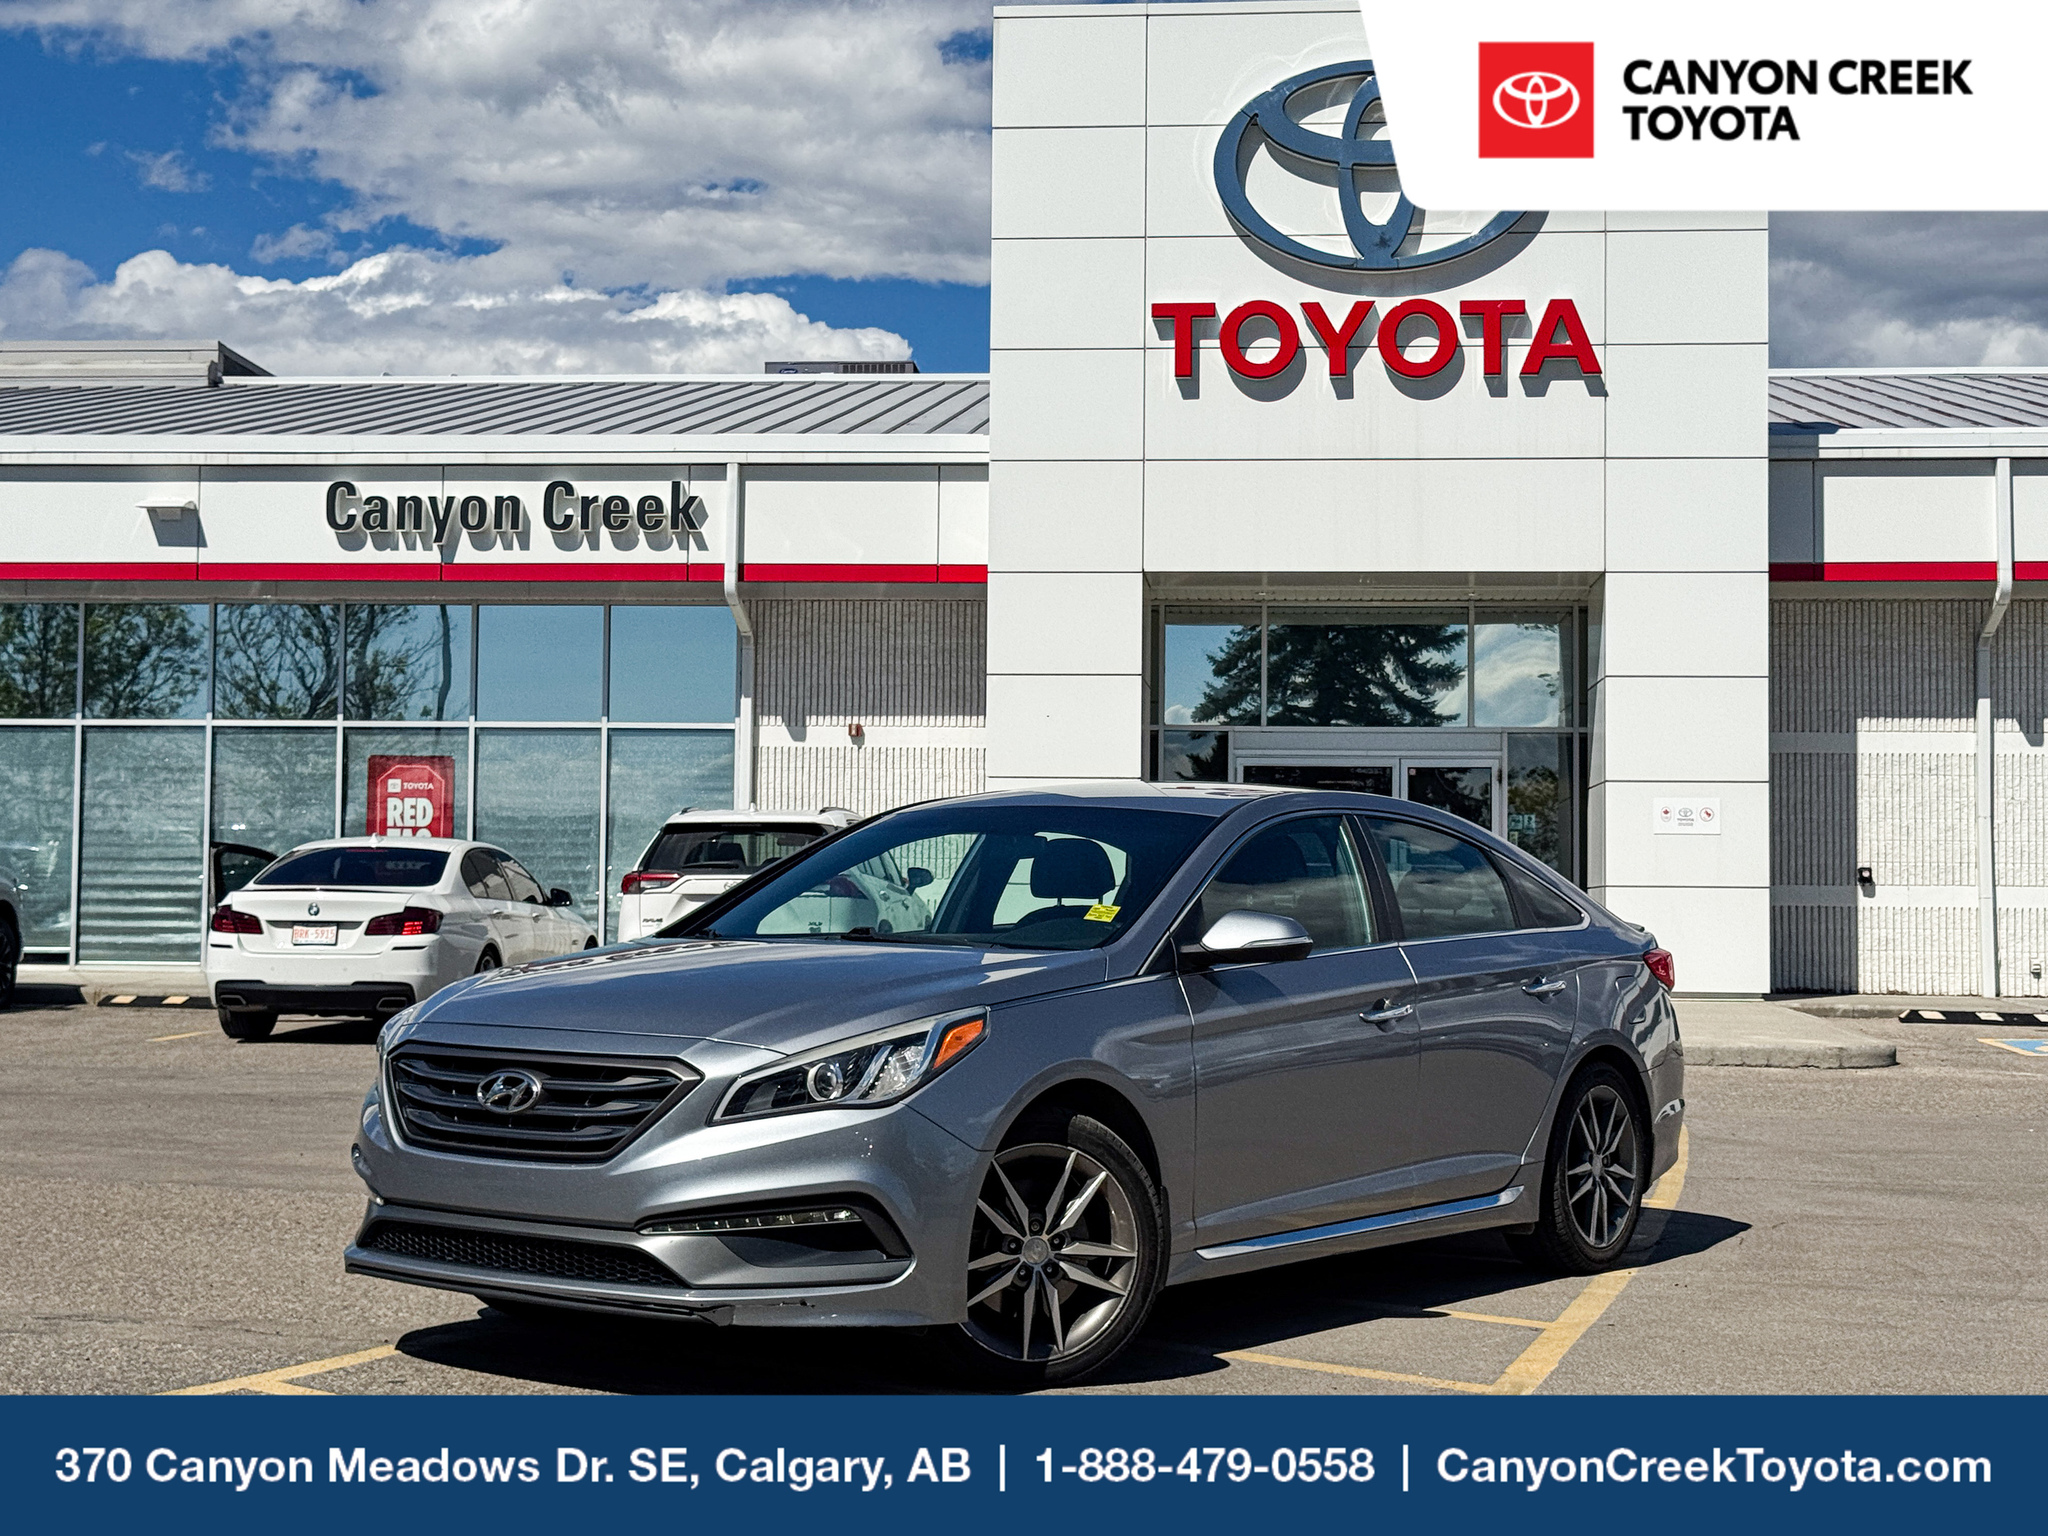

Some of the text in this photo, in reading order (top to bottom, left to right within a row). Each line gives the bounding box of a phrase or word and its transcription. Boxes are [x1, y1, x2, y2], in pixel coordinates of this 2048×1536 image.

[1151, 299, 1602, 379] TOYOTA
[325, 480, 700, 543] Canyon Creek
[403, 781, 435, 790] TOYOTA
[386, 797, 434, 828] RED
